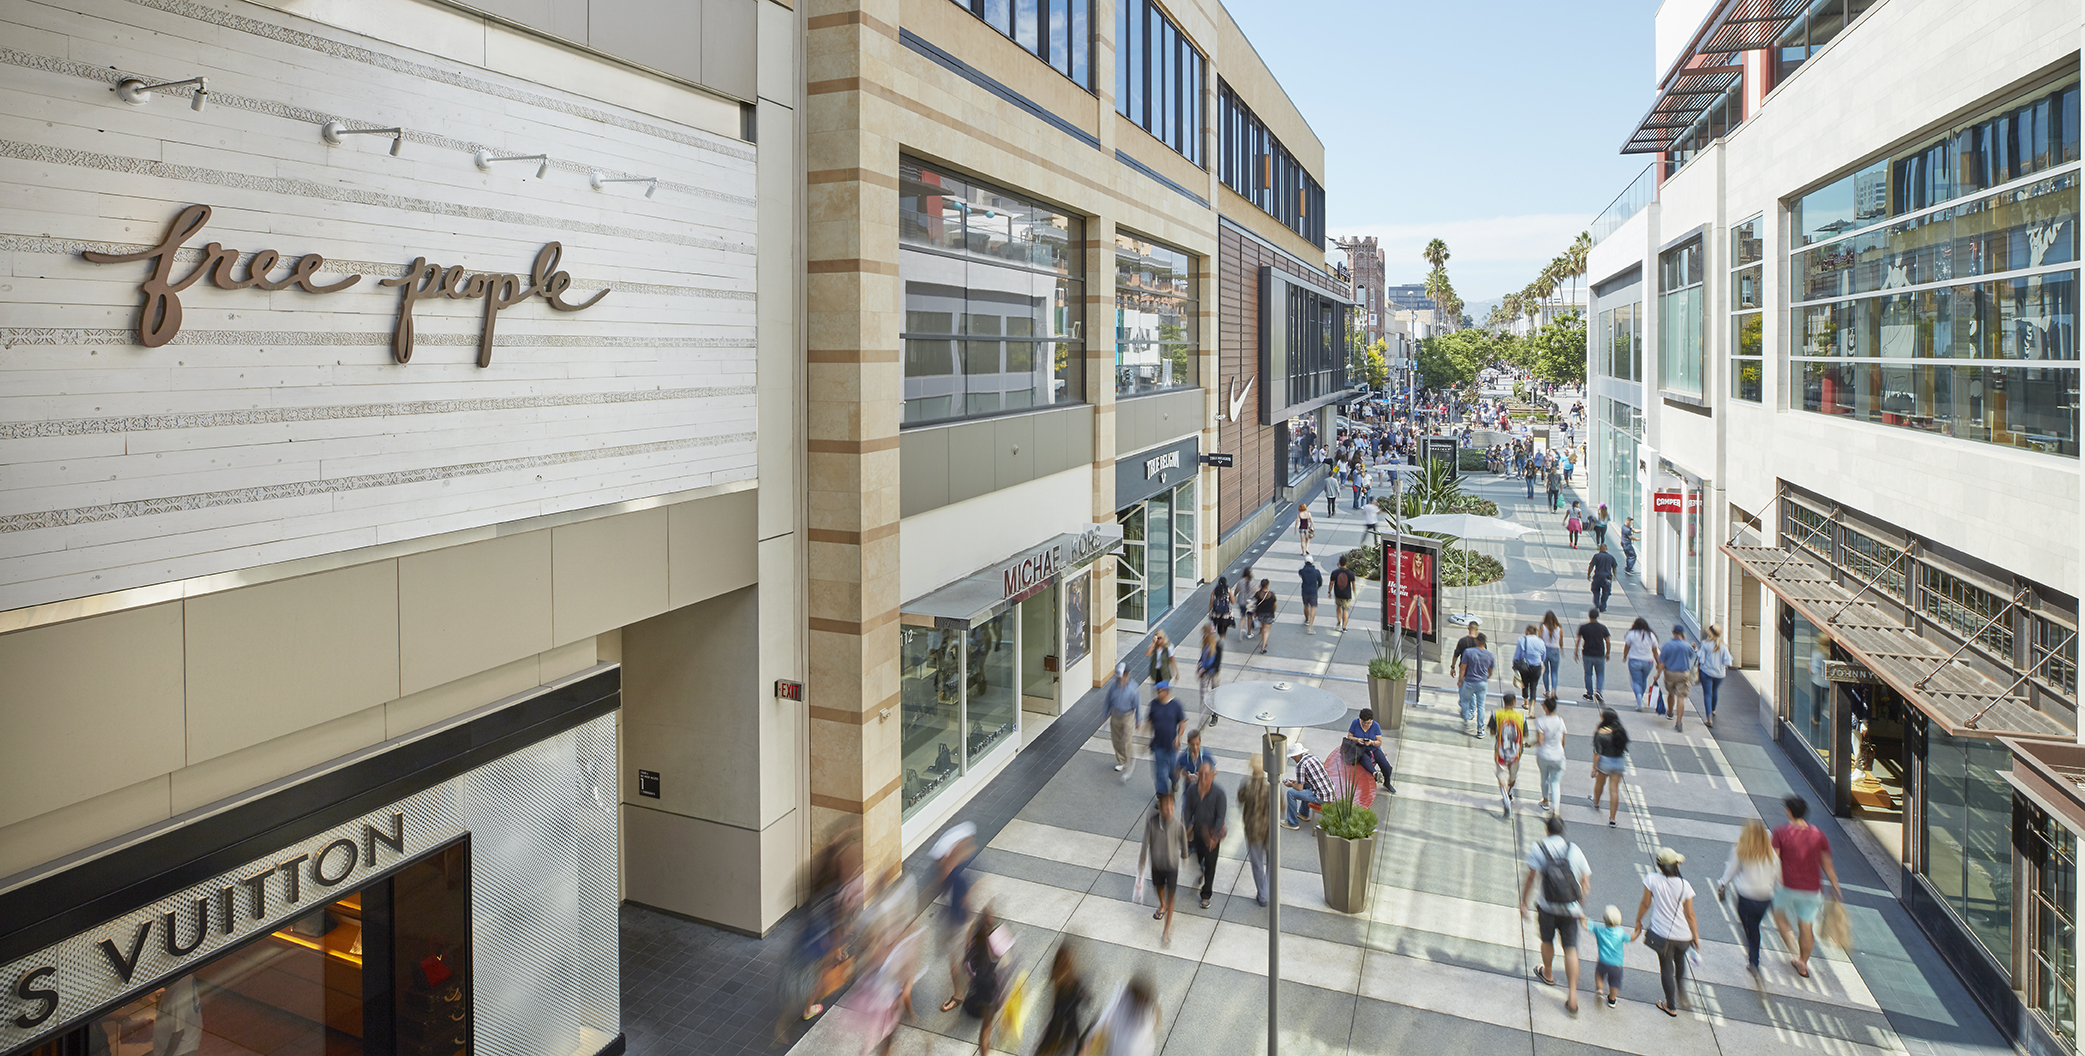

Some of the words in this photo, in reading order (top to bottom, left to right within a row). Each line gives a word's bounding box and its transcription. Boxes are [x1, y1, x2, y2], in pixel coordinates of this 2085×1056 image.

[82, 204, 361, 348] free
[379, 241, 611, 367] people
[1146, 456, 1160, 480] TRUE
[1655, 497, 1681, 508] CAMPER
[1002, 542, 1068, 600] MICHAEL
[1069, 525, 1102, 564] KORS
[900, 629, 914, 647] 112
[1829, 668, 1876, 679] JOHNNY
[781, 682, 799, 700] EXIT
[10, 966, 60, 1029] S
[98, 811, 404, 985] VUITTON
